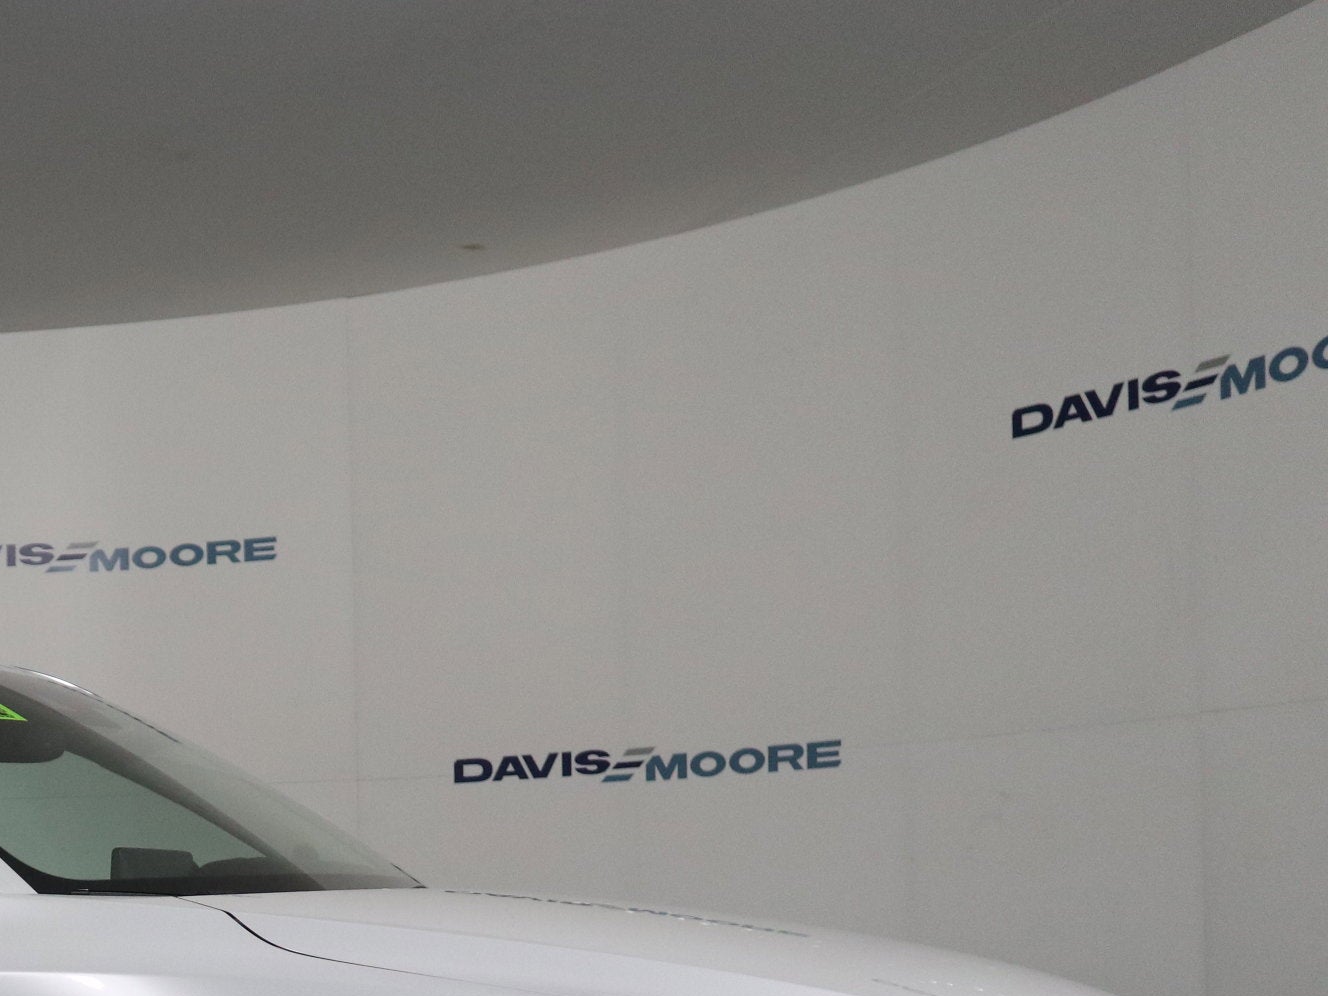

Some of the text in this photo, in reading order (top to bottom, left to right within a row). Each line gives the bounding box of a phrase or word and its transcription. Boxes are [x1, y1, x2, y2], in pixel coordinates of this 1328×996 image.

[1011, 369, 1182, 439] DAVIS
[89, 536, 277, 572] MOORE
[453, 739, 842, 784] DAVIS MOORE
